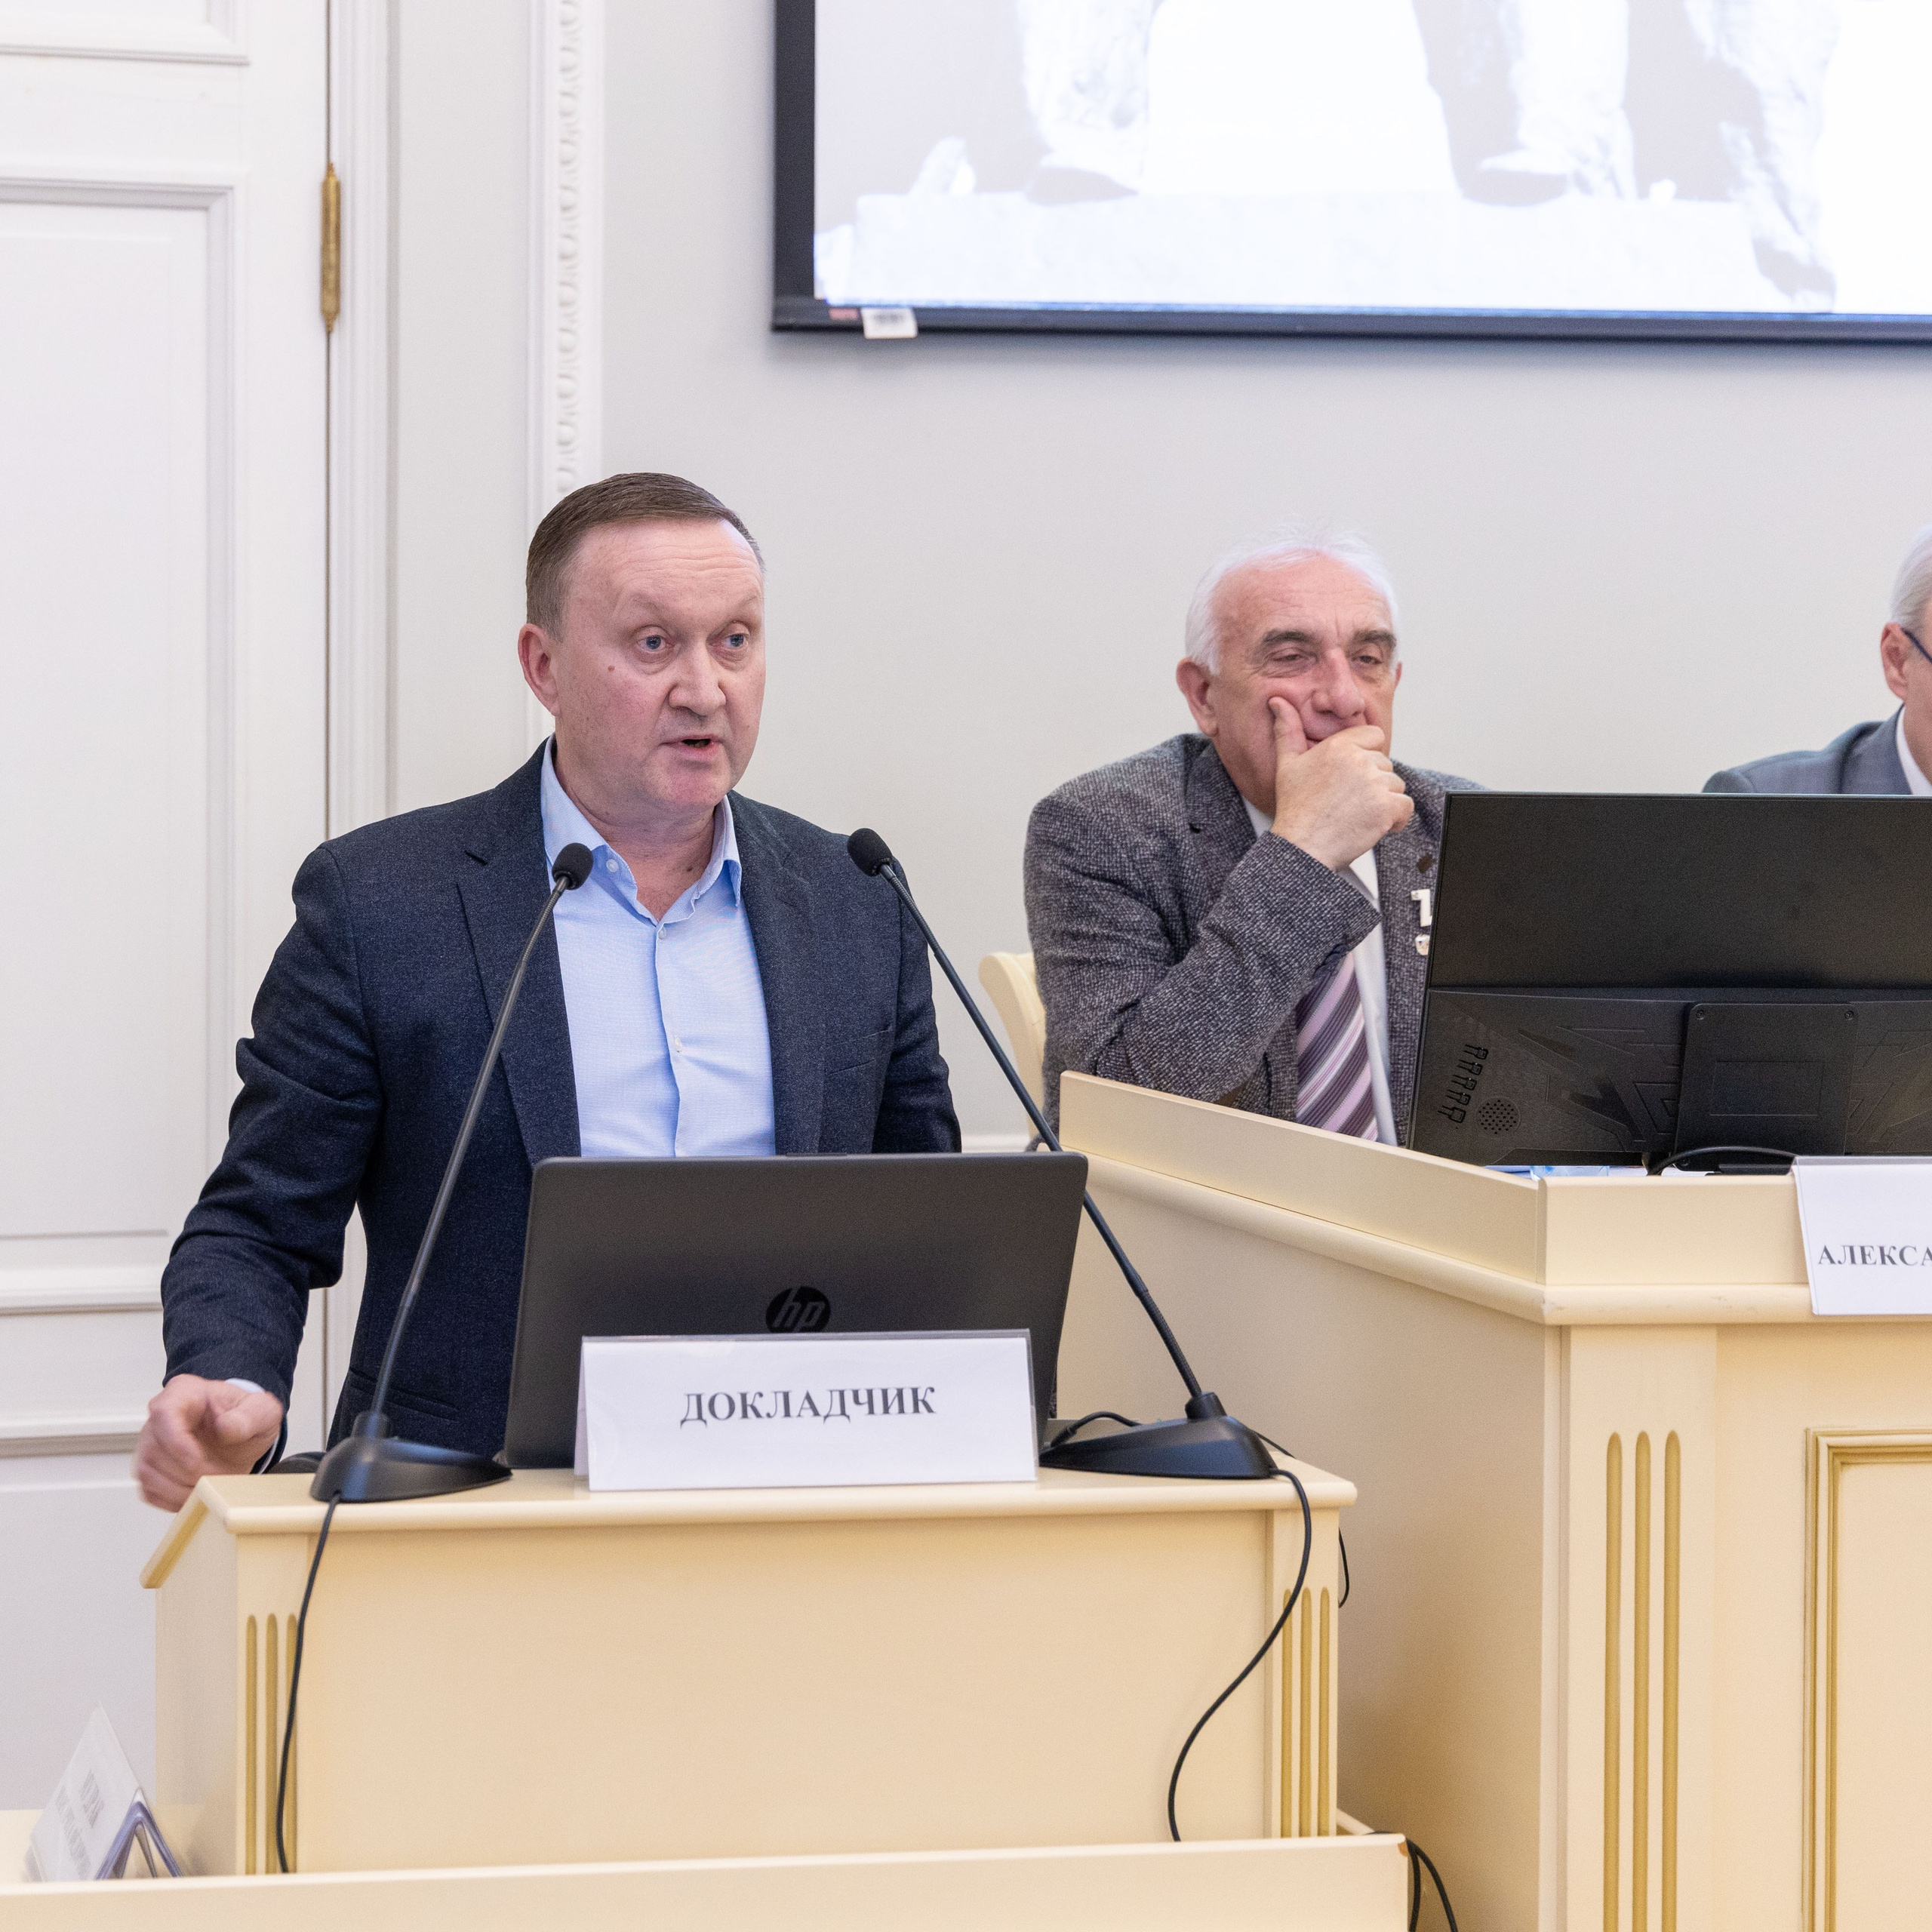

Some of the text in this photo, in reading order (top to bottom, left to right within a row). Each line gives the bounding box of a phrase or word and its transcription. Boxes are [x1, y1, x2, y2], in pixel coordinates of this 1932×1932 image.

[1818, 1244, 1932, 1266] АЛЕКСА
[771, 1287, 826, 1333] hp
[680, 1386, 936, 1429] ДОКЛАДЧИК
